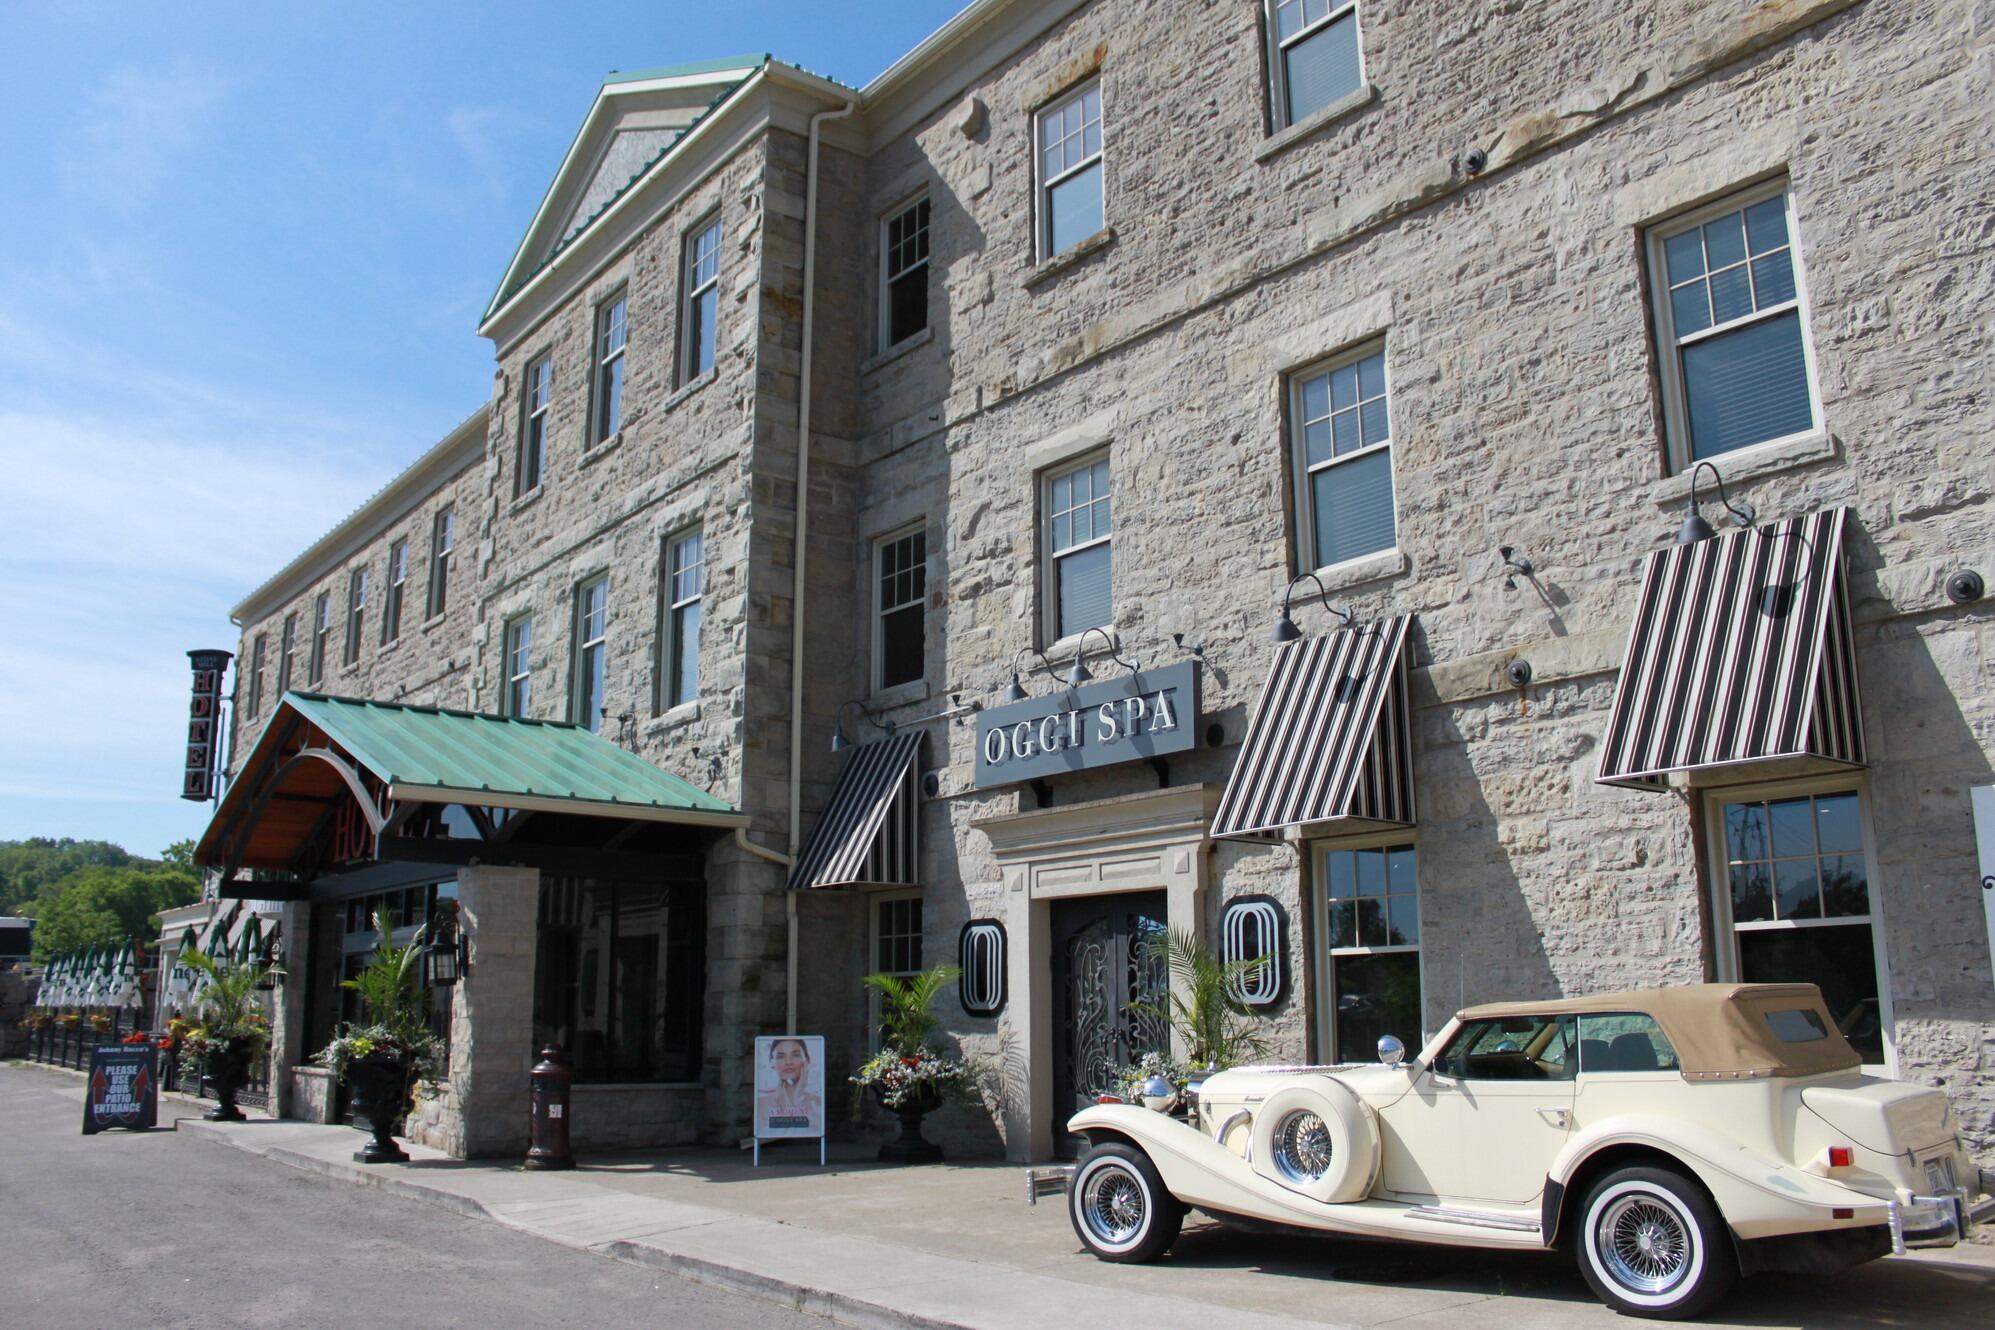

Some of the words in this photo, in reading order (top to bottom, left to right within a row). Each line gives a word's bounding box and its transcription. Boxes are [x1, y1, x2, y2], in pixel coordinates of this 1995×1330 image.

[186, 670, 211, 791] HOTEL
[984, 709, 1079, 764] OGGI
[1098, 690, 1176, 742] SPA
[105, 1064, 138, 1075] PLEASE
[111, 1075, 129, 1084] USE
[109, 1084, 130, 1094] OUR
[105, 1093, 131, 1103] PATIO
[94, 1102, 141, 1114] ENTRANCE
